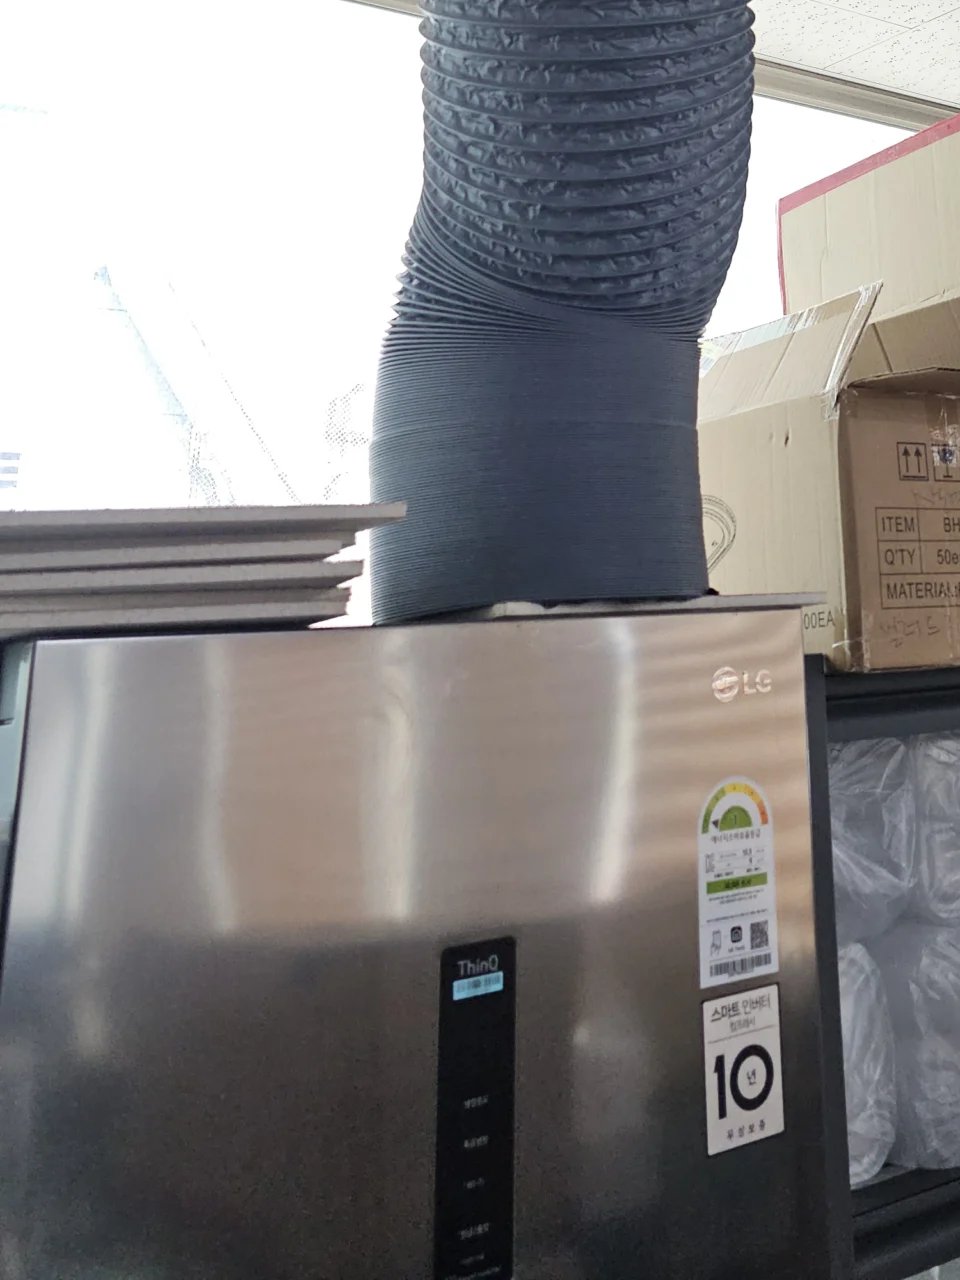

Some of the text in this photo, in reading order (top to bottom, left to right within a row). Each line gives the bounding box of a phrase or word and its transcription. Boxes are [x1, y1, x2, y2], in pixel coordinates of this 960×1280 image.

[881, 516, 915, 533] ITEM
[884, 548, 916, 565] Q'TY
[743, 669, 772, 695] LG
[711, 993, 771, 1022] 스마트 인버터
[713, 1044, 774, 1120] 10
